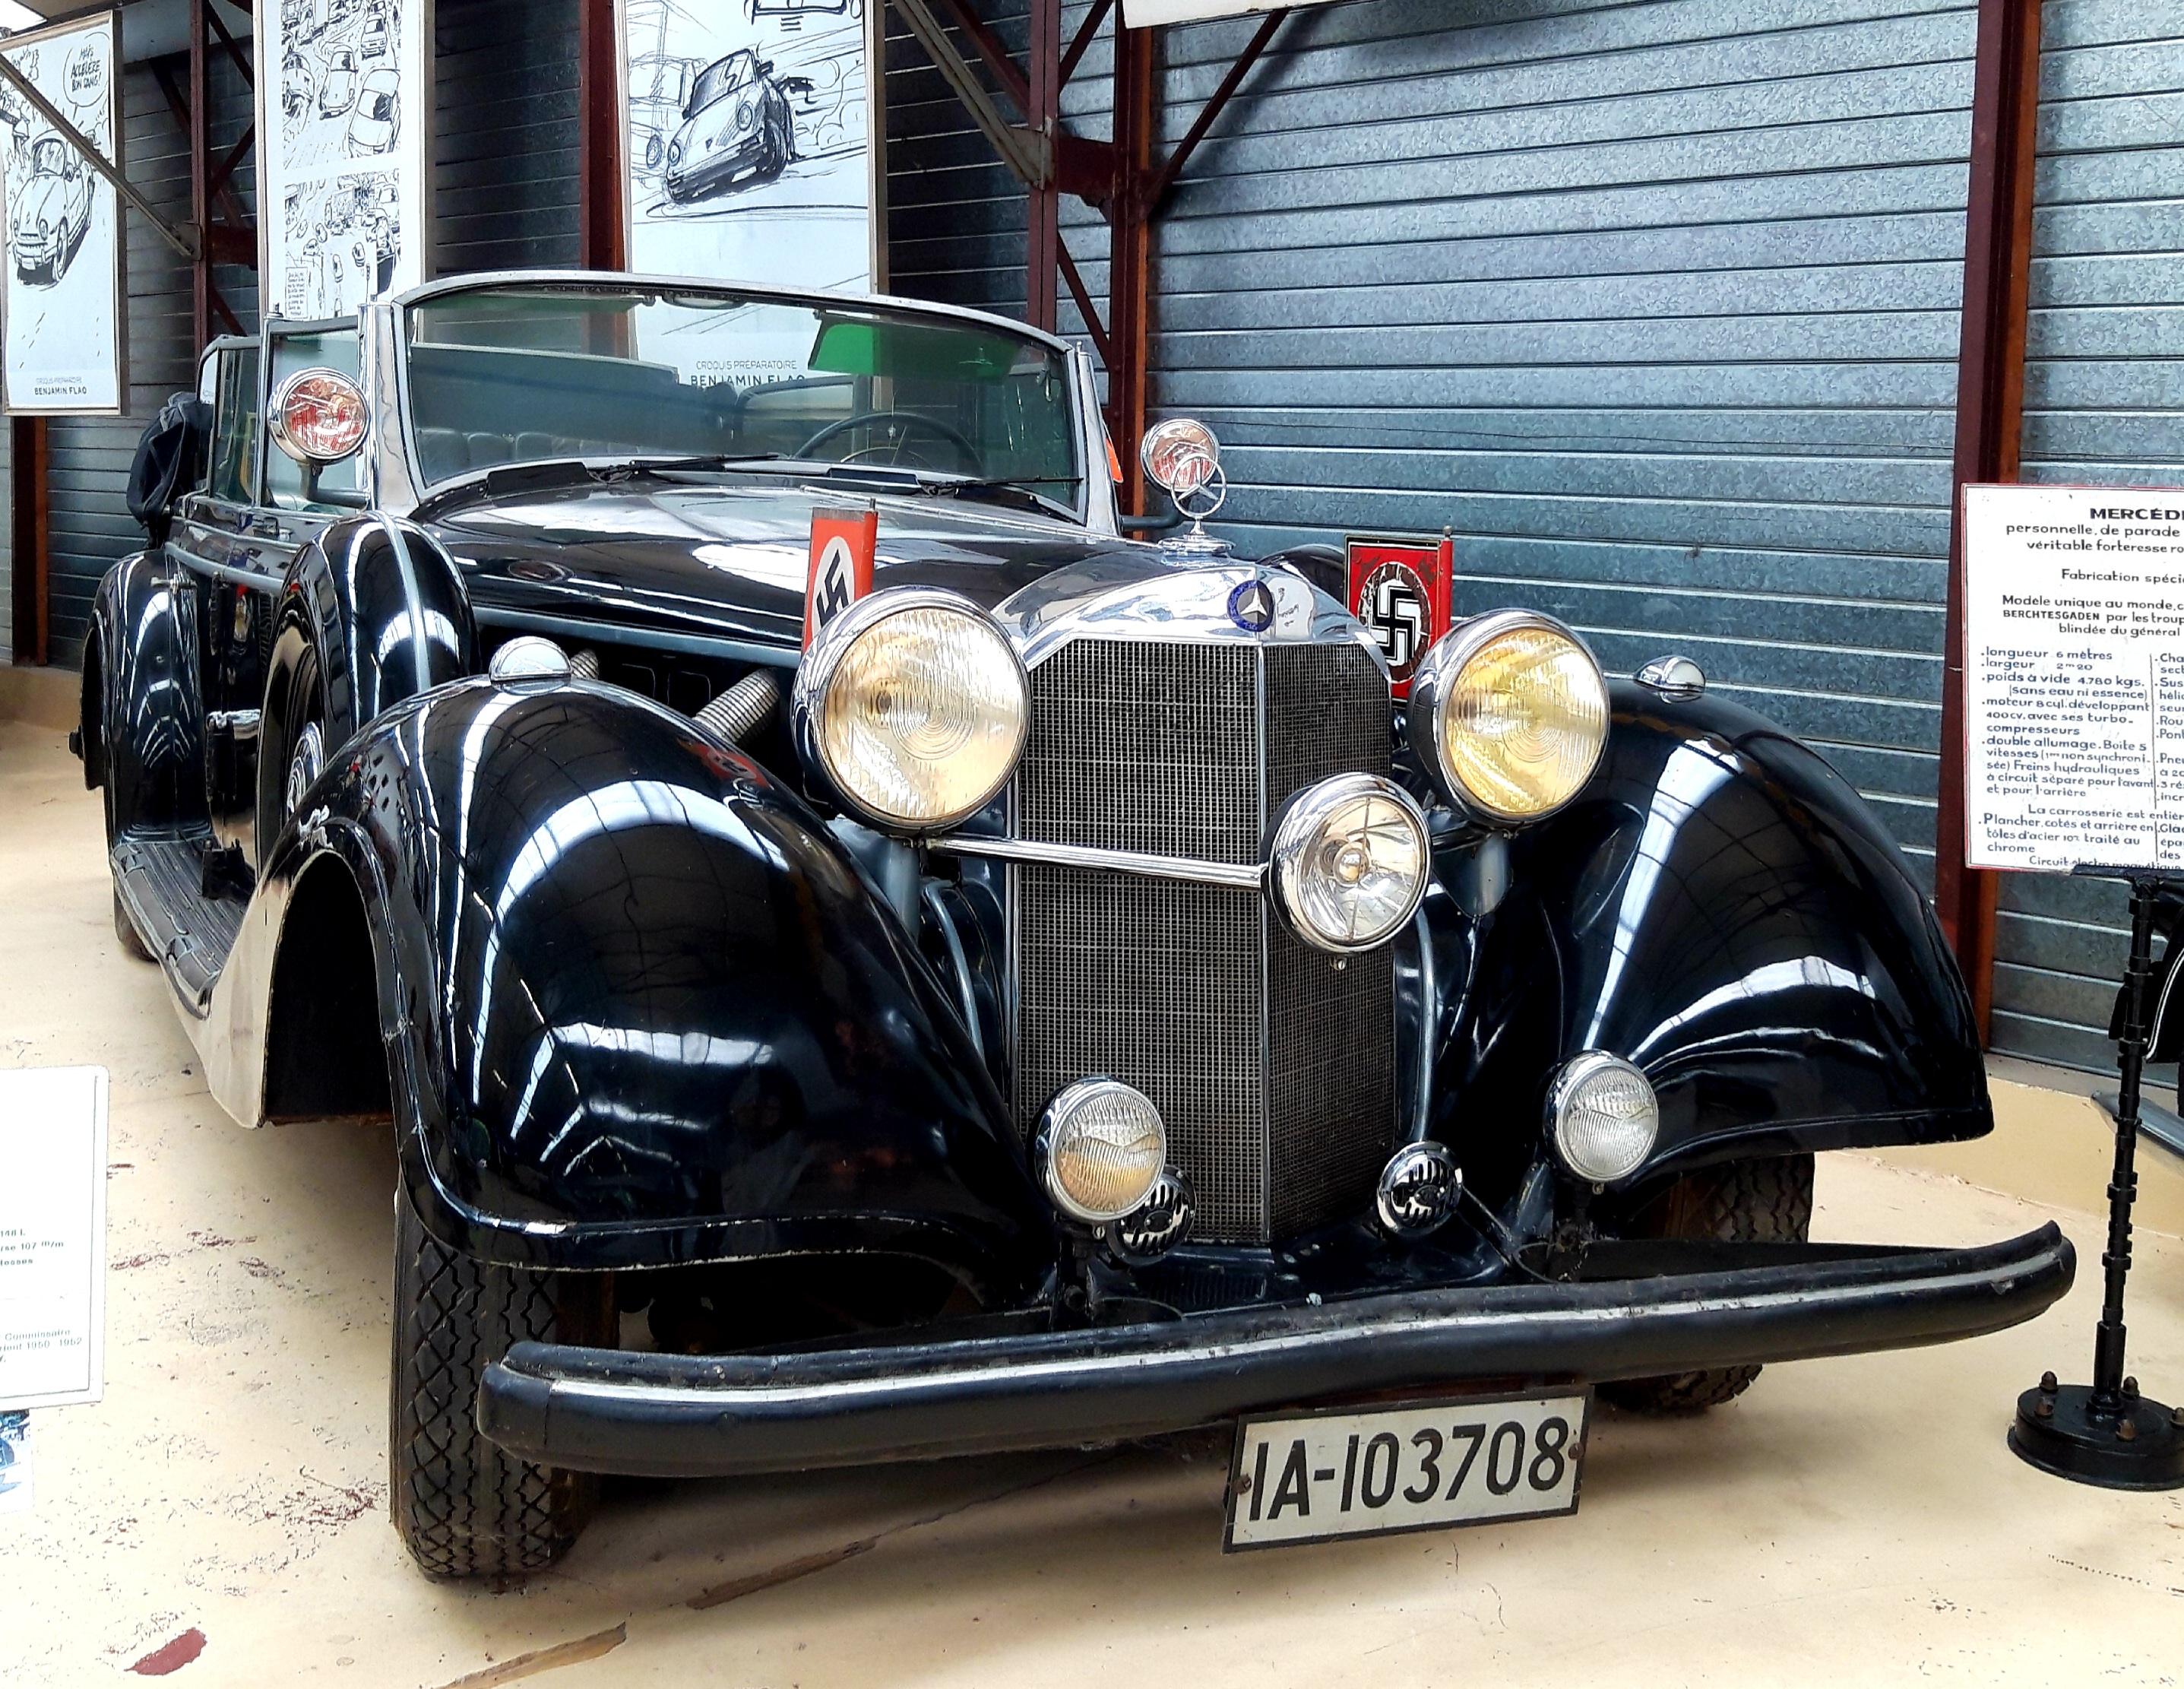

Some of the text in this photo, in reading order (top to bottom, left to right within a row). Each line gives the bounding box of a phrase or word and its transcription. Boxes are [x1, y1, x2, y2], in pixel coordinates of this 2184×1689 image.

[34, 386, 68, 395] BENJAMIN
[2090, 508, 2184, 521] MERCÉD
[2100, 524, 2119, 535] de
[2125, 525, 2180, 538] parade
[2027, 539, 2094, 550] véritable
[2097, 539, 2167, 553] forteresse
[2062, 569, 2184, 585] Fabrication spéci
[2002, 594, 2050, 606] Modèle
[2055, 597, 2101, 609] unique
[2003, 610, 2100, 620] BERCHTESGADEN
[2106, 614, 2128, 623] par
[2132, 611, 2148, 623] les
[2059, 623, 2180, 639] blindée du général
[2067, 648, 2112, 660] mètres
[1986, 671, 2024, 683] poids
[2027, 674, 2037, 683] à
[2040, 673, 2071, 684] vide
[2049, 688, 2074, 696] eau
[2077, 688, 2089, 696] ni
[2092, 689, 2148, 702] essence)
[1986, 725, 2080, 735] compresseurs
[1986, 747, 2039, 758] vitesses
[2014, 759, 2050, 771] Freins
[2054, 761, 2140, 776] hydrauliques
[1986, 772, 2154, 787] à circuit séparé pour l'avant
[1986, 784, 1999, 793] et
[2003, 787, 2033, 795] pour
[2028, 803, 2046, 814] La
[2049, 808, 2122, 818] carrosserie
[2126, 810, 2145, 819] est
[2081, 820, 2091, 829] et
[2094, 821, 2138, 831] arrière
[2018, 830, 2060, 841] d'acier
[2084, 832, 2120, 844] traité
[2123, 837, 2140, 845] au
[1987, 841, 2035, 852] chrome
[2160, 850, 2181, 860] des
